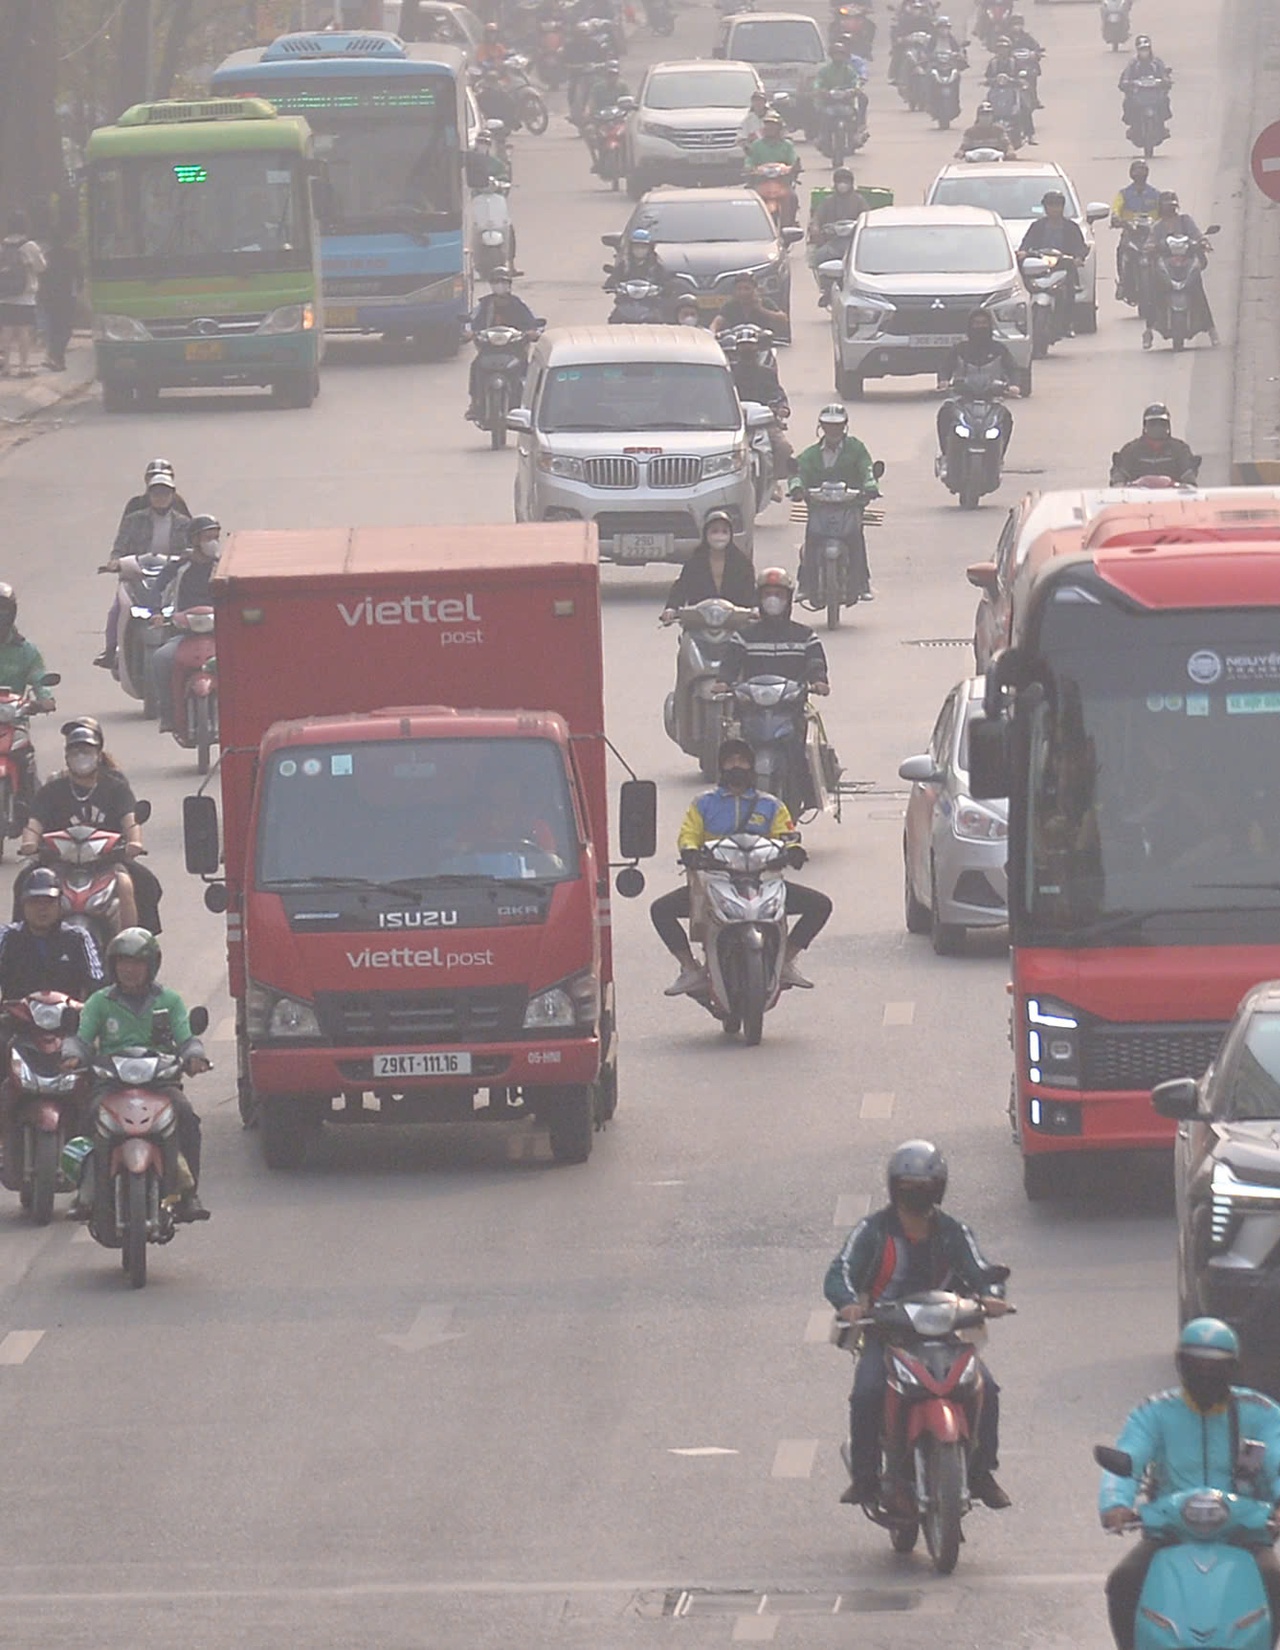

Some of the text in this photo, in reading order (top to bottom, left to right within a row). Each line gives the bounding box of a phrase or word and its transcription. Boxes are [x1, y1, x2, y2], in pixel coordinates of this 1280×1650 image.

[336, 593, 481, 627] viettel
[440, 629, 483, 646] post
[379, 911, 457, 927] ISUZU
[346, 947, 494, 969] viettel post
